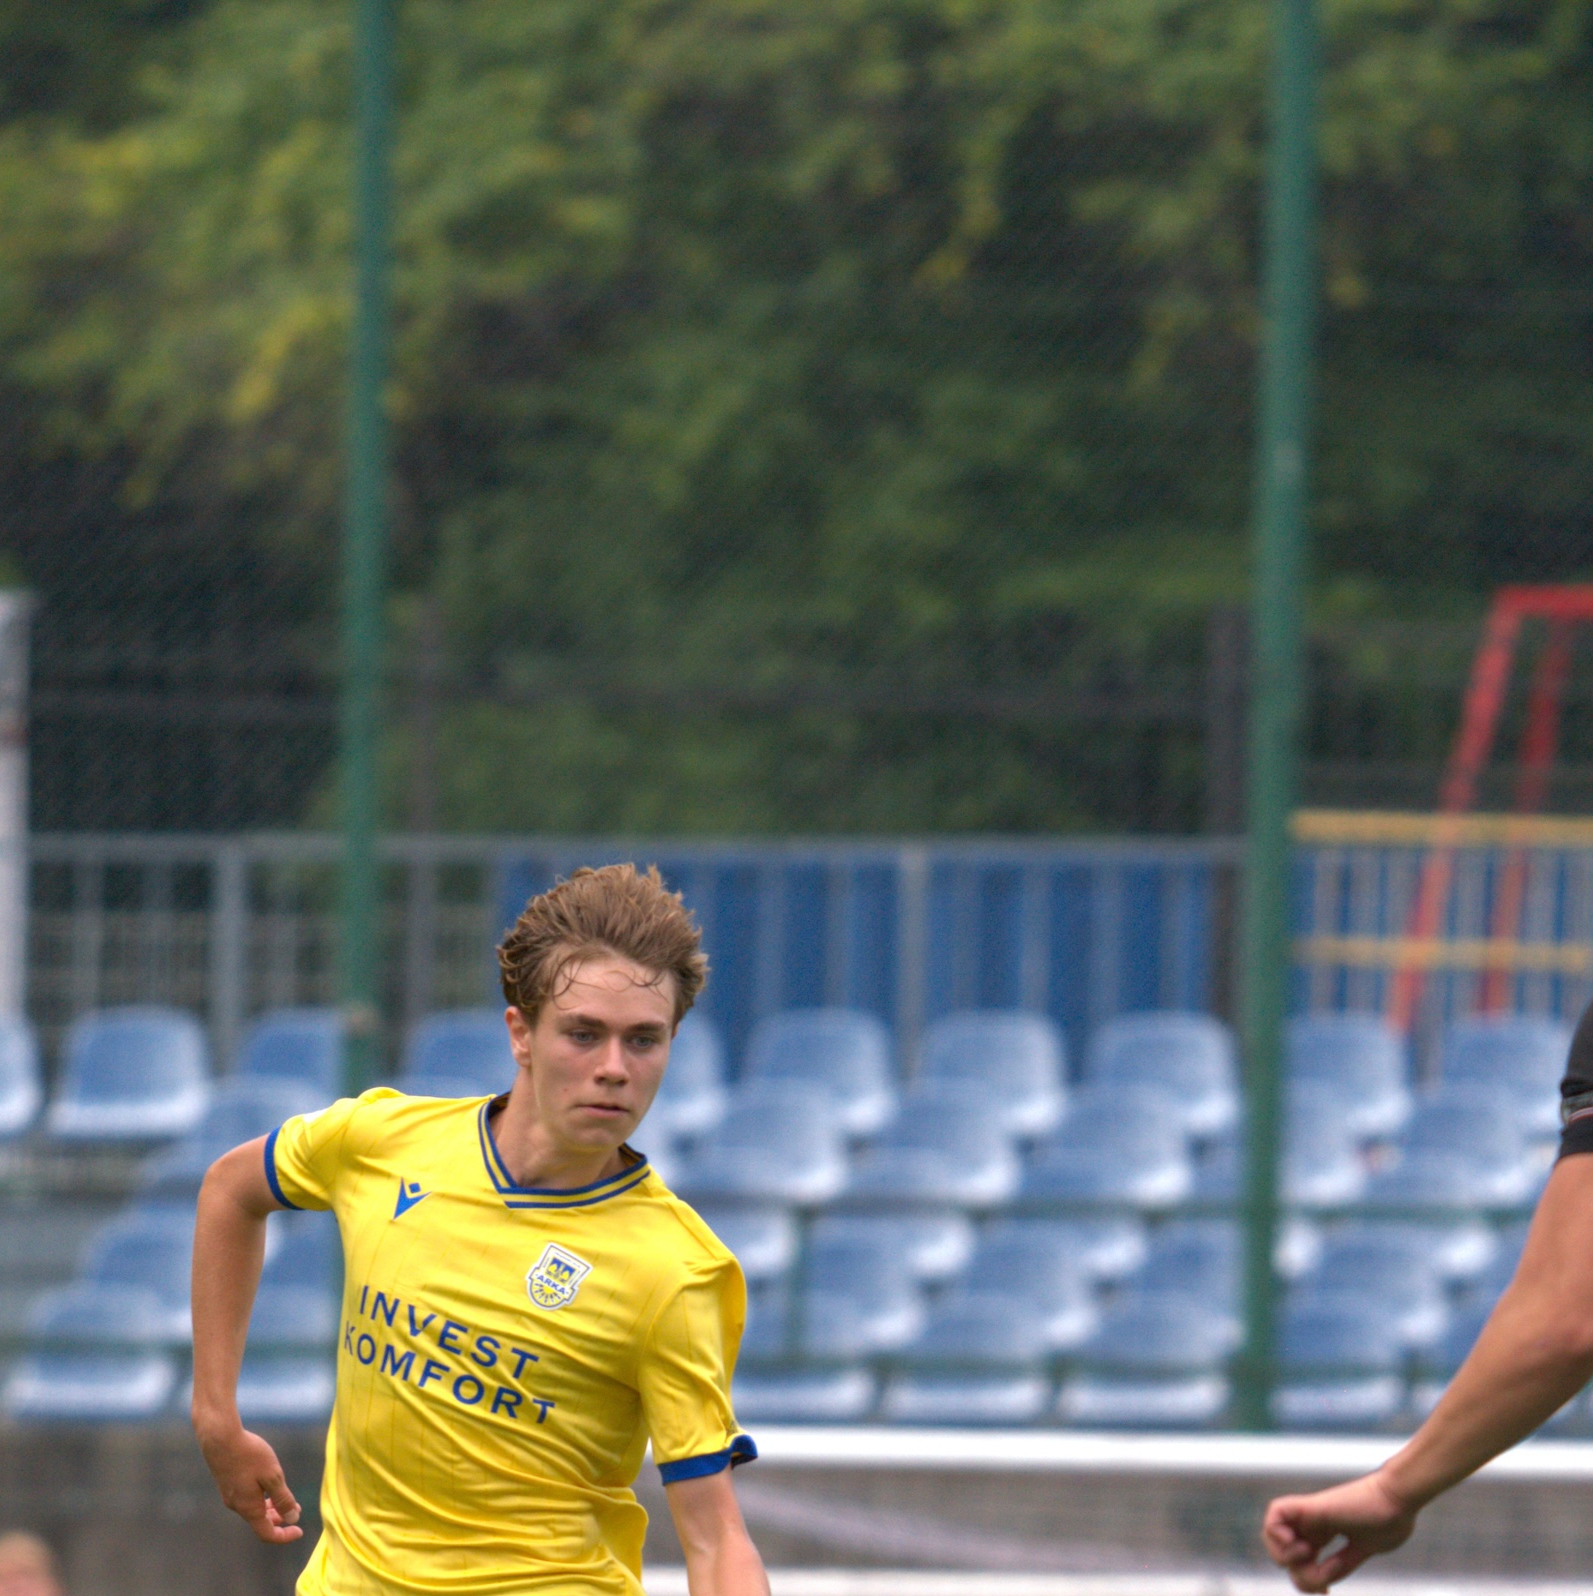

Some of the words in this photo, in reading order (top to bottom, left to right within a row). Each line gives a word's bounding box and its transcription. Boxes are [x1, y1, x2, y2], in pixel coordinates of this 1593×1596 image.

[537, 1274, 566, 1295] ARKA
[343, 1320, 556, 1424] KOMFORT
[359, 1285, 539, 1380] INVEST
